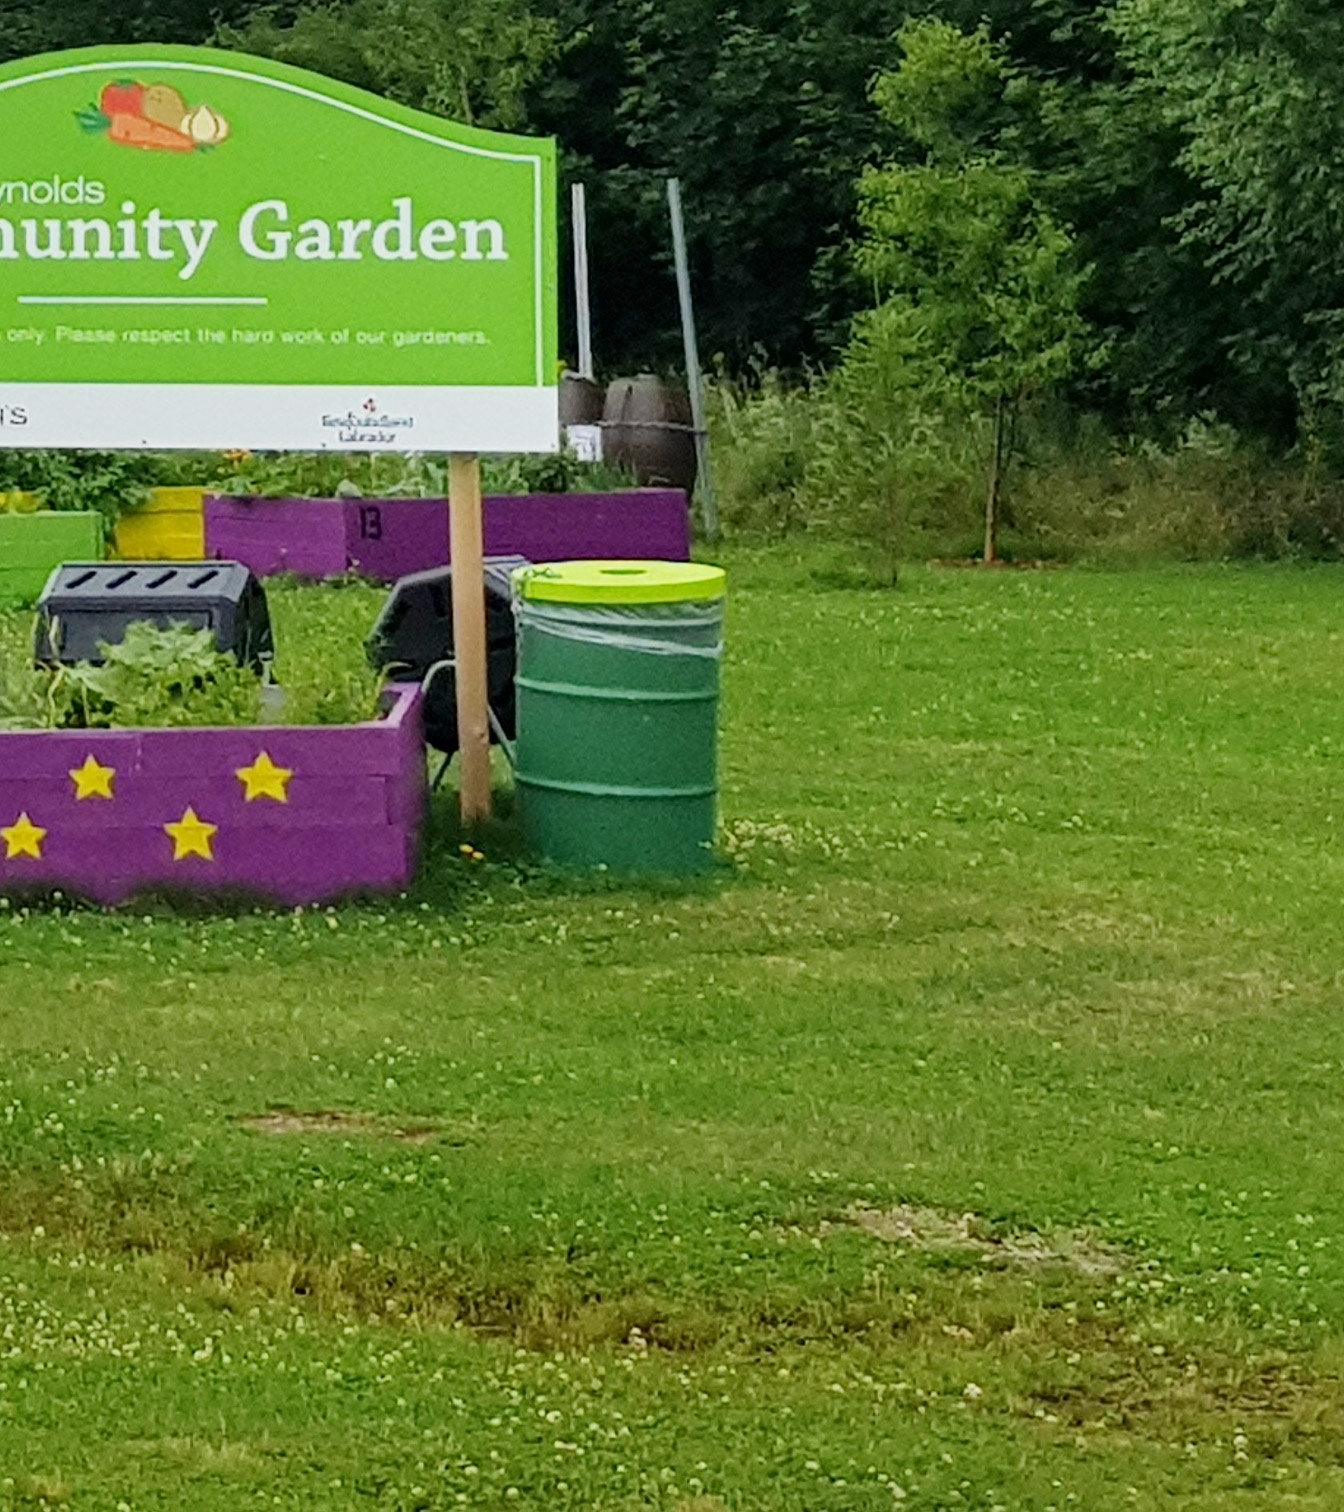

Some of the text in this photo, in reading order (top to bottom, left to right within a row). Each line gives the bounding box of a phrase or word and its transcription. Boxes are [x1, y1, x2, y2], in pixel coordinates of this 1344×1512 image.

[238, 196, 509, 260] Garden
[55, 326, 116, 343] Please
[122, 328, 190, 346] respect
[198, 328, 226, 343] the
[232, 328, 274, 343] hard
[281, 328, 325, 344] work
[332, 328, 350, 344] of
[356, 331, 385, 344] our
[392, 329, 492, 348] gardeners.
[359, 506, 383, 540] 13
